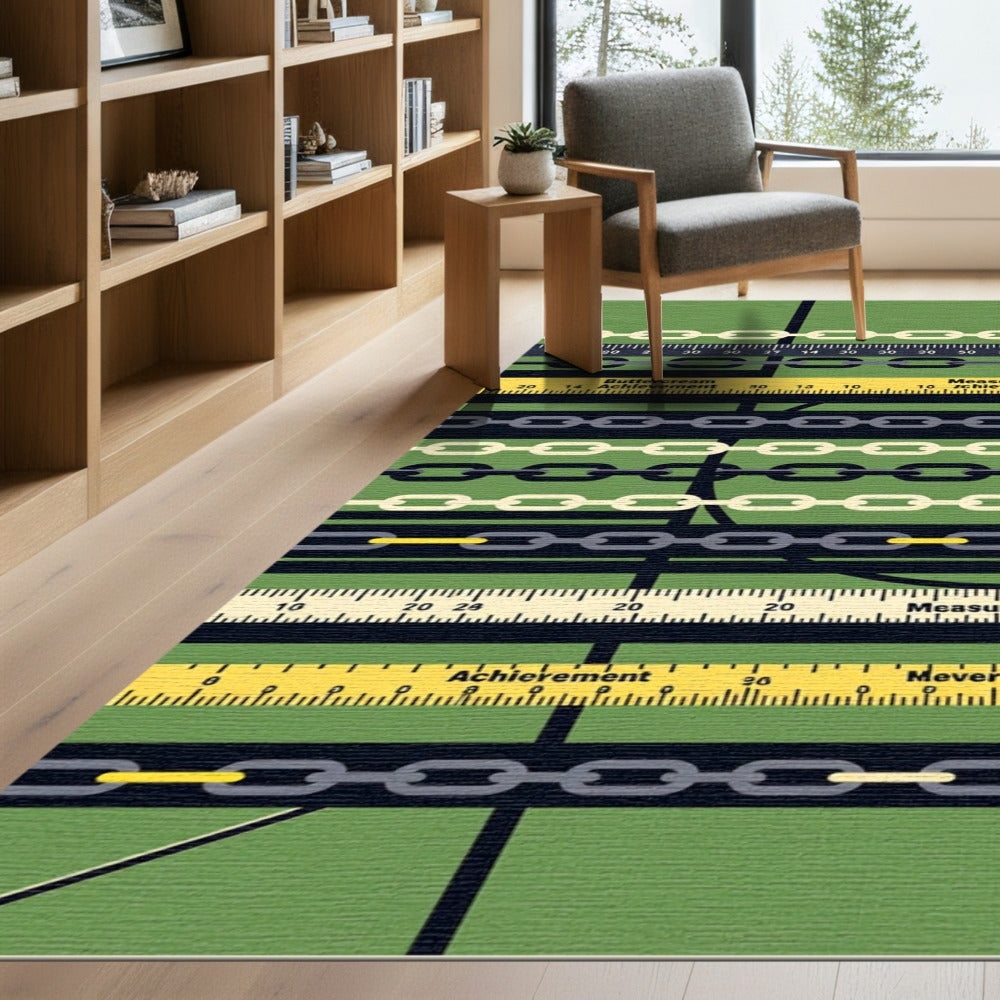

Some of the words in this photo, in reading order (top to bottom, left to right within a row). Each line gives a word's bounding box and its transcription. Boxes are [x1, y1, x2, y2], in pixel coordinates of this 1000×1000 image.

[402, 603, 434, 611] 20
[612, 603, 643, 611] 20
[764, 603, 795, 611] 20
